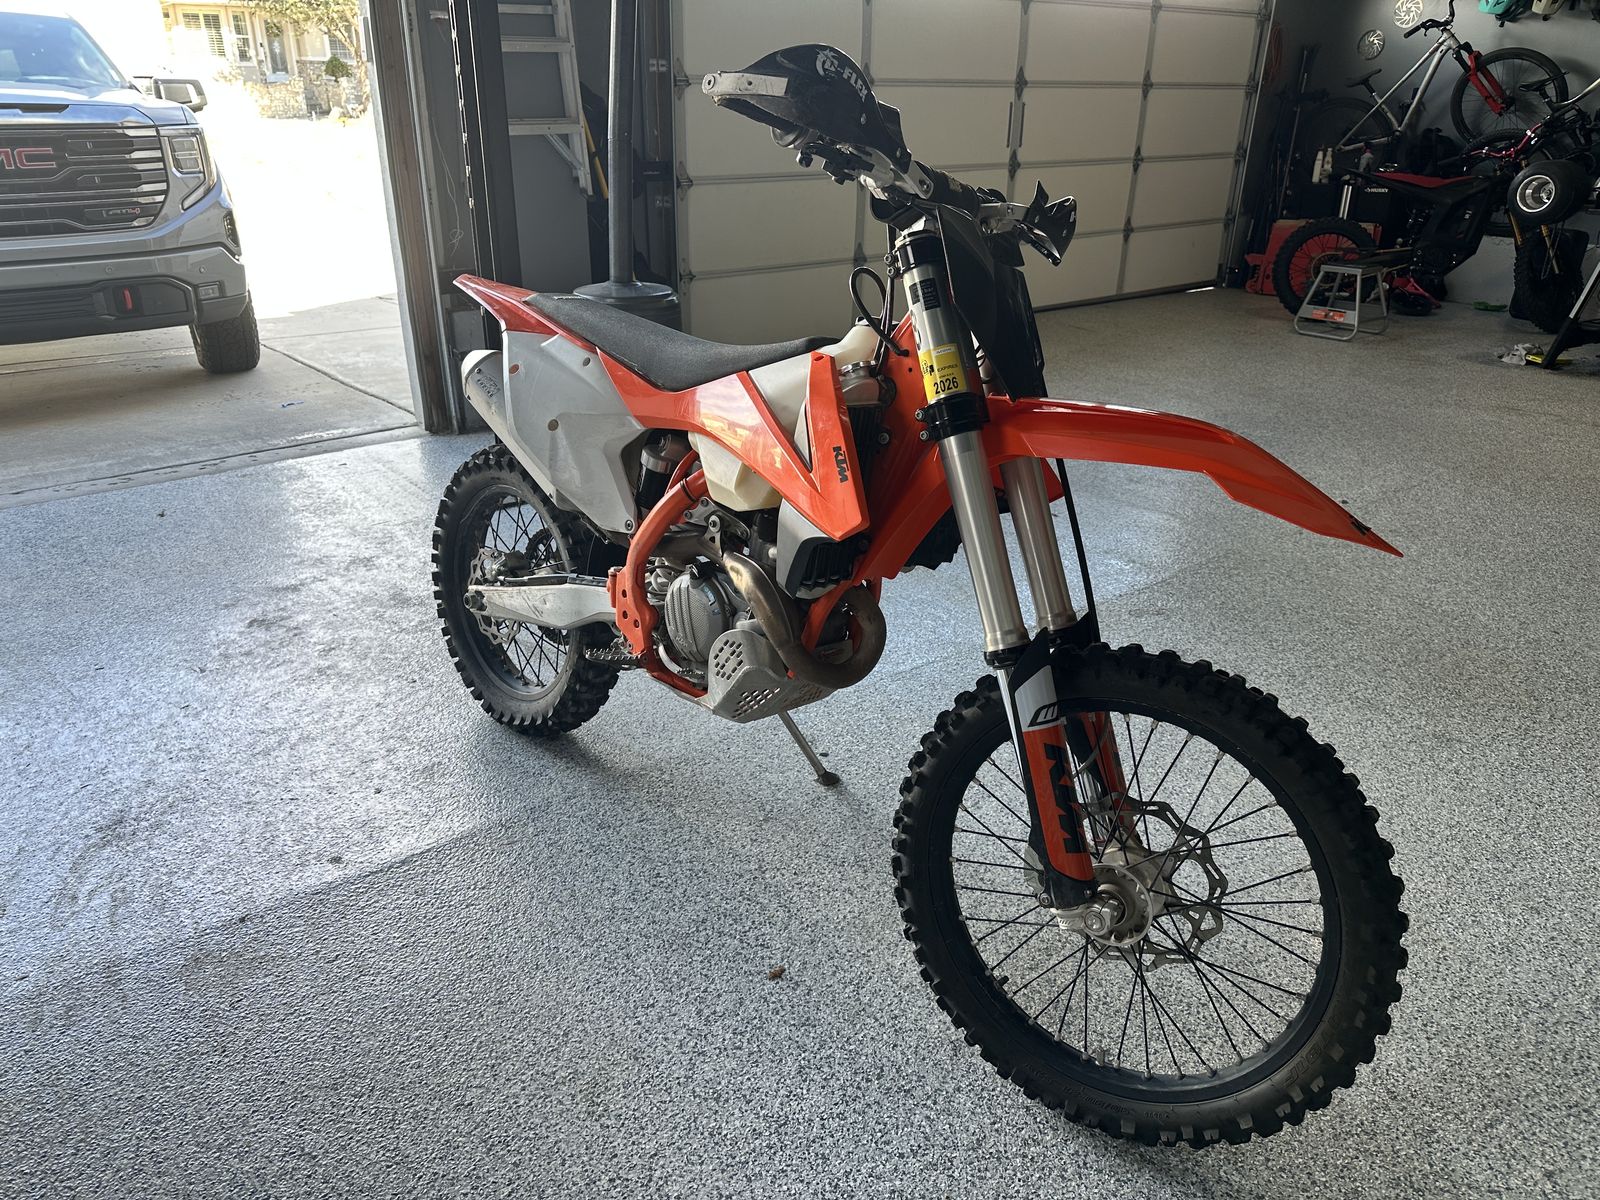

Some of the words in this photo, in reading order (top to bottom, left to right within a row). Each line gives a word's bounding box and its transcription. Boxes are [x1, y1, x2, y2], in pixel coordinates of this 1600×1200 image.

[936, 363, 959, 373] EXPIRES
[933, 376, 960, 395] 2026
[832, 446, 849, 484] KTM
[1043, 743, 1089, 854] KTM
